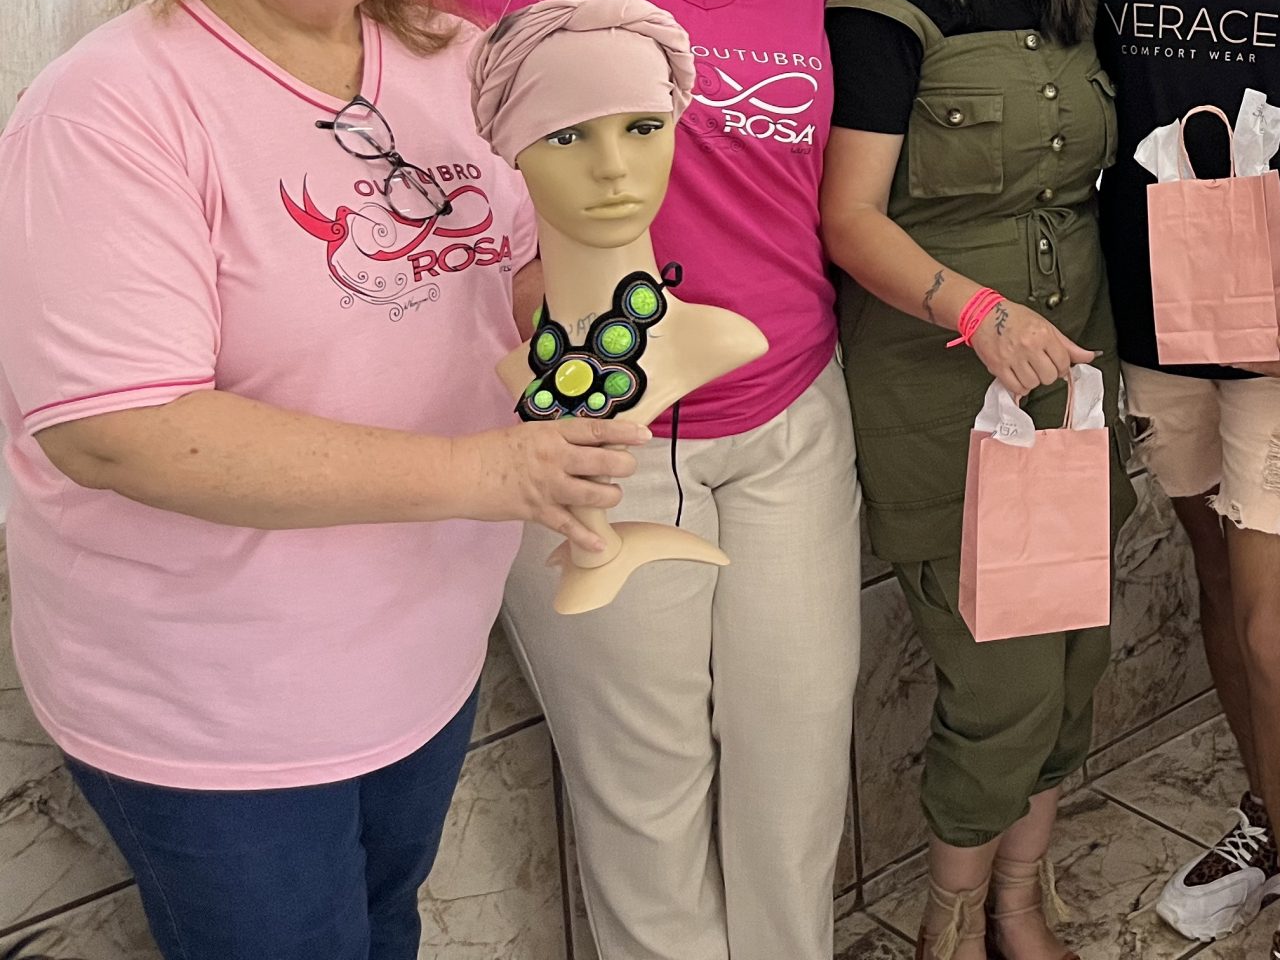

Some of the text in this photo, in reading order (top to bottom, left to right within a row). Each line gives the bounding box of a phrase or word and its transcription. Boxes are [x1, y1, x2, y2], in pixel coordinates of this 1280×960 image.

[691, 45, 823, 71] OUTUBRO
[1121, 44, 1256, 63] COMFORT WEAR
[721, 108, 816, 145] ROSA
[407, 235, 512, 282] ROSA
